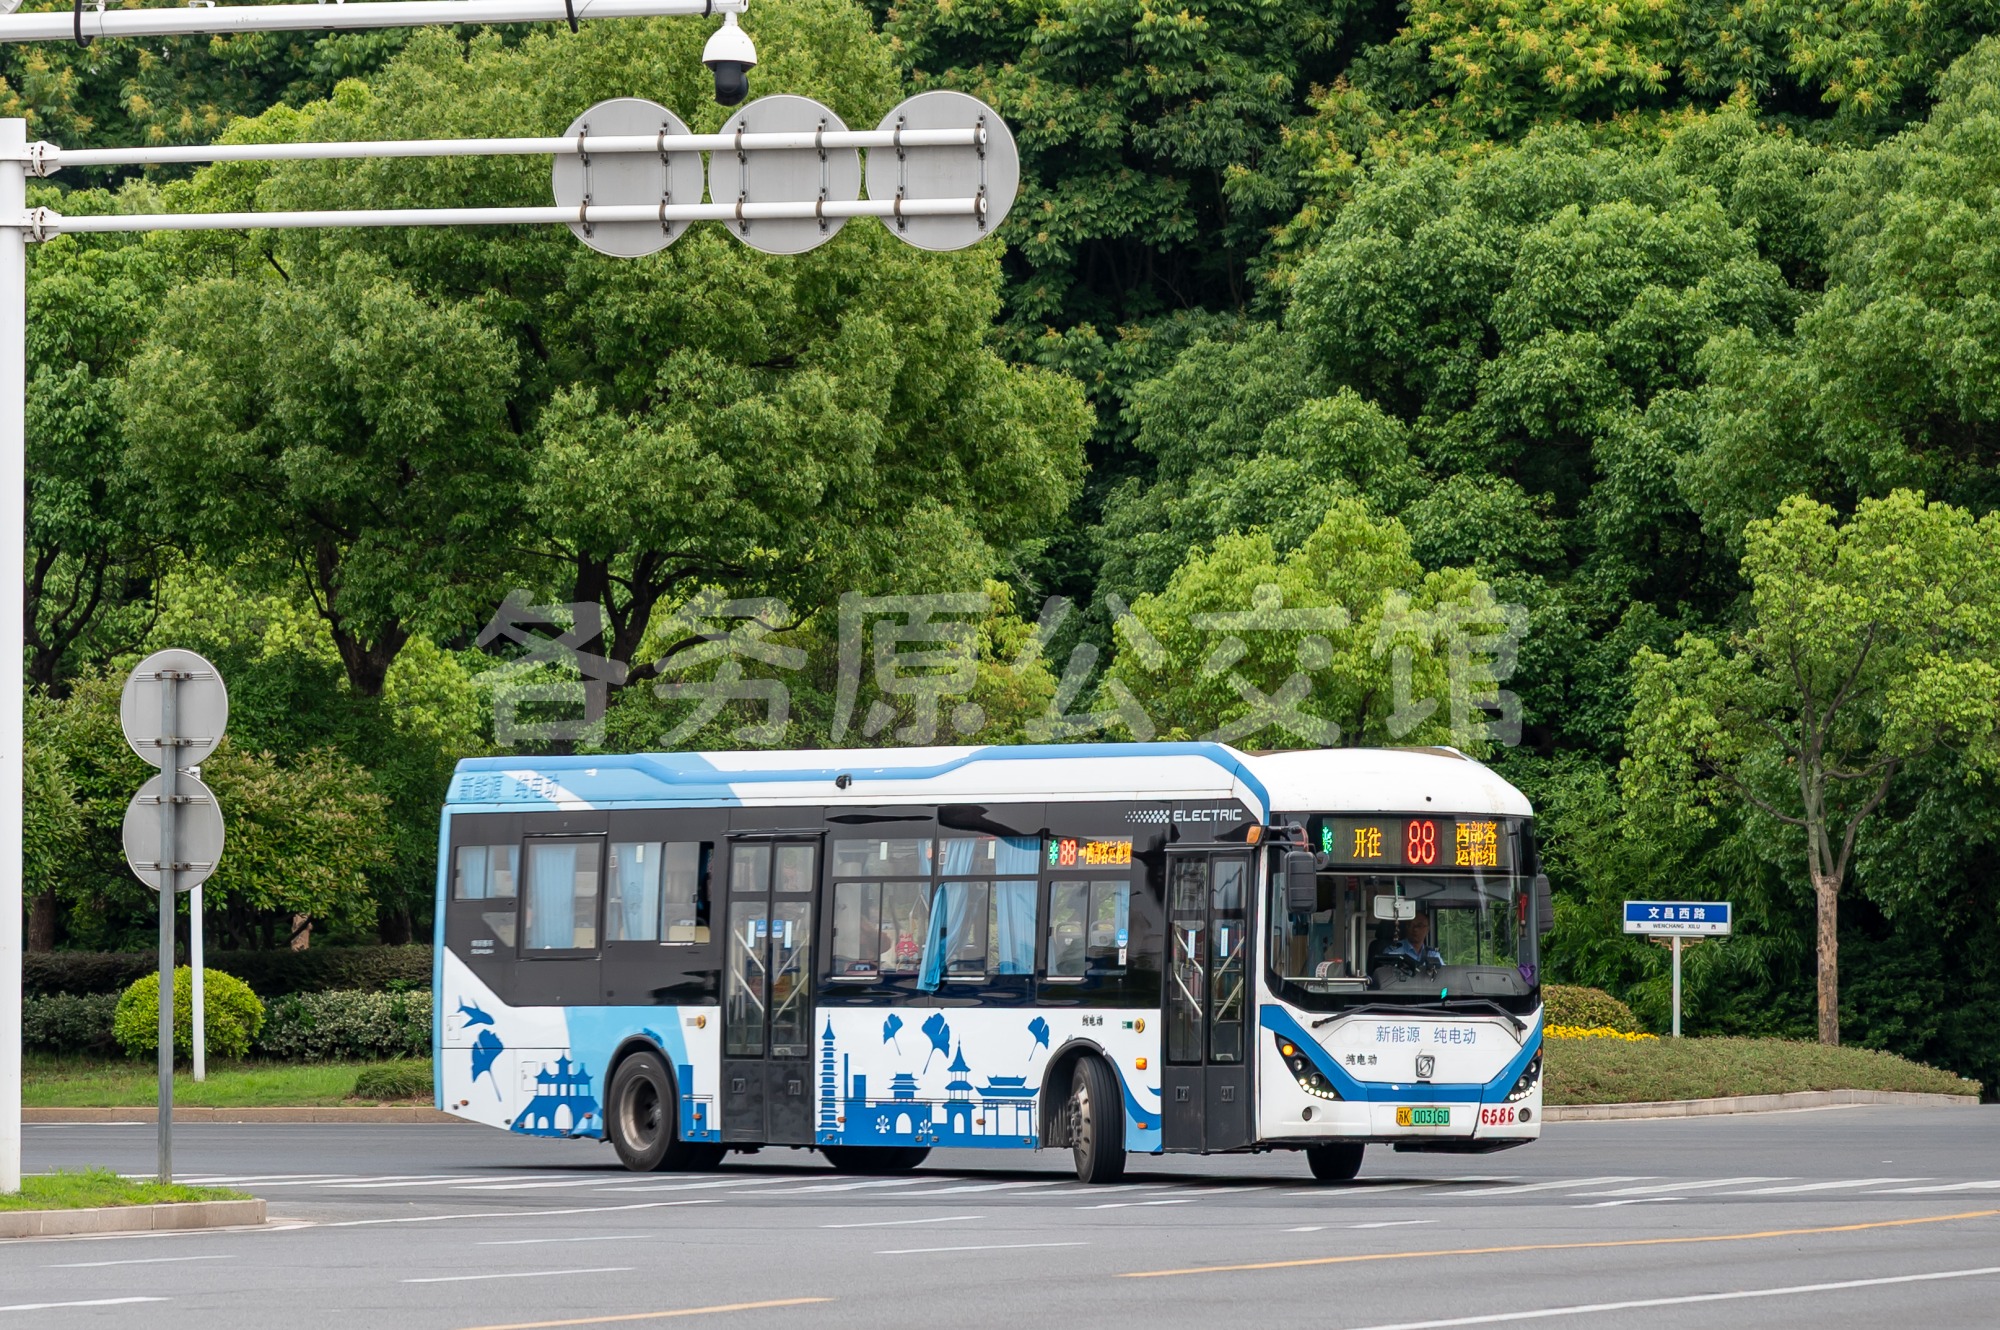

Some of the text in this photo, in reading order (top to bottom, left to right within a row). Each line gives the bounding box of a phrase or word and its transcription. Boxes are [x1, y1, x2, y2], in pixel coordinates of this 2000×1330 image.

[460, 773, 560, 800] 新能源 纯电动
[1173, 808, 1242, 822] ELECTRIC
[1353, 820, 1497, 864] 开往 88 西部客
[1060, 839, 1077, 866] 88
[1455, 844, 1497, 866] 运枢纽
[1648, 906, 1705, 920] 文昌西路
[1082, 1014, 1103, 1026] 纯电动
[1376, 1026, 1476, 1044] 新能源 纯电动
[1345, 1053, 1377, 1066] 纯电动
[1481, 1106, 1515, 1125] 6586
